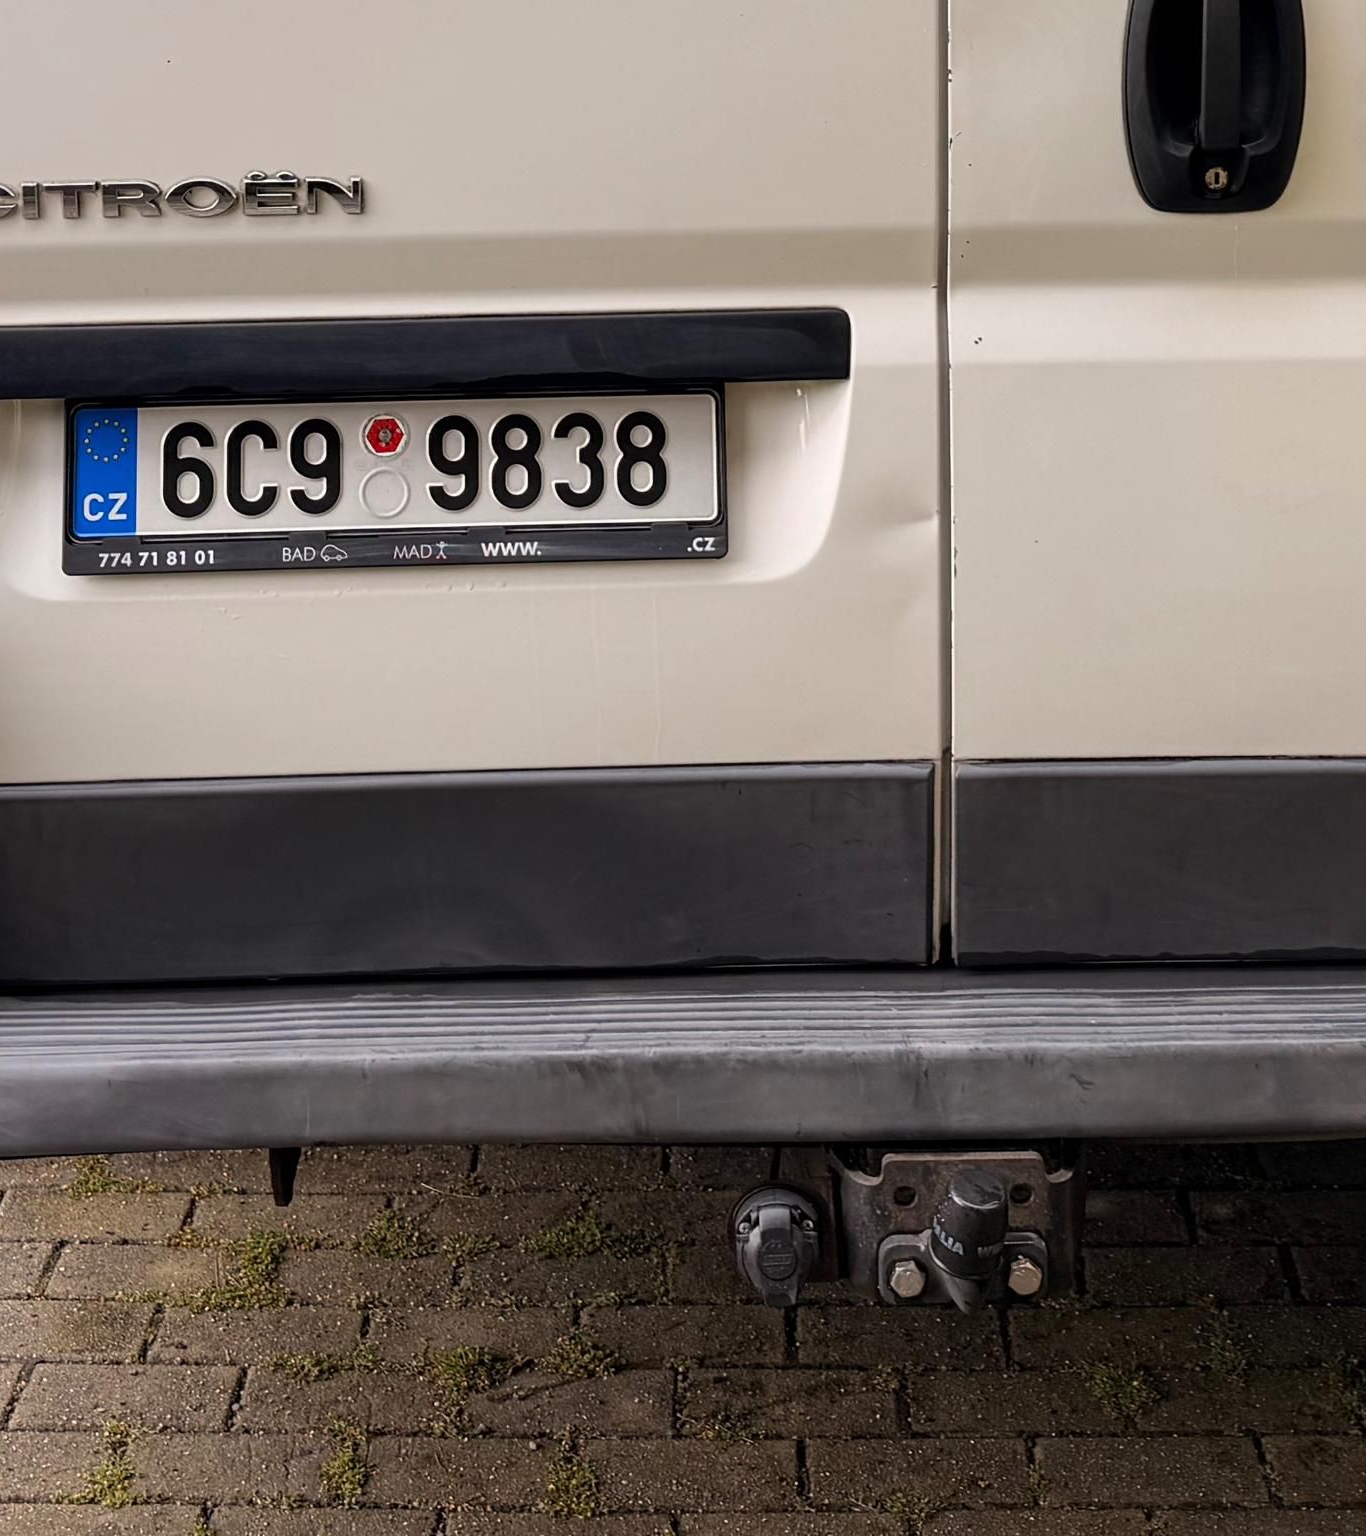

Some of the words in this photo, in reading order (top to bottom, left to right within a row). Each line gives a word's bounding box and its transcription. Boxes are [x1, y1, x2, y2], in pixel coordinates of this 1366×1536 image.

[161, 418, 343, 519] 6C9
[426, 411, 668, 511] 9838
[83, 492, 128, 522] CZ
[98, 552, 132, 568] 774
[138, 551, 159, 567] 71
[166, 550, 186, 566] 81
[194, 549, 215, 565] 01
[282, 546, 316, 562] BAD
[393, 544, 433, 560] MAD
